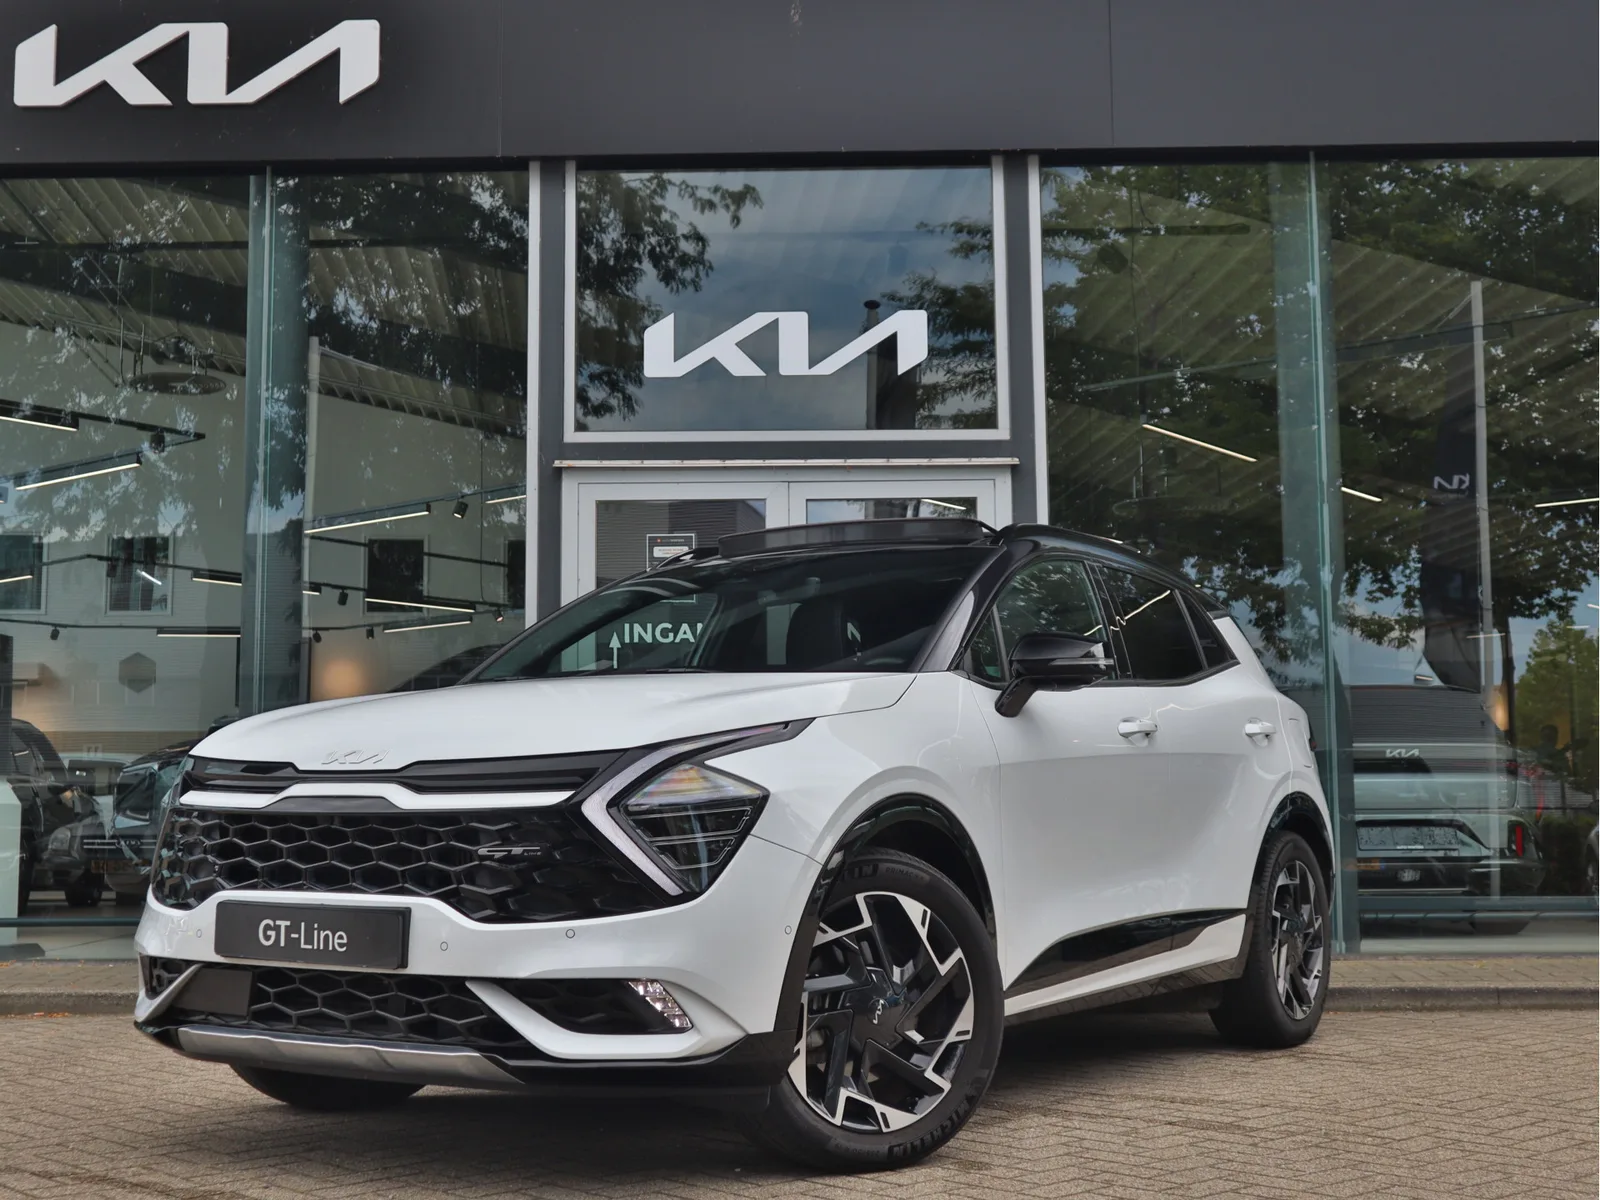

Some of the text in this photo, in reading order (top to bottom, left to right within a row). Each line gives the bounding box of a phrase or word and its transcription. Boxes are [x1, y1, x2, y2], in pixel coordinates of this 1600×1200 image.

[14, 19, 381, 107] KIA
[643, 309, 929, 378] KIA
[624, 622, 704, 643] INGA
[1385, 748, 1420, 758] KIA
[258, 918, 348, 952] GT-Line
